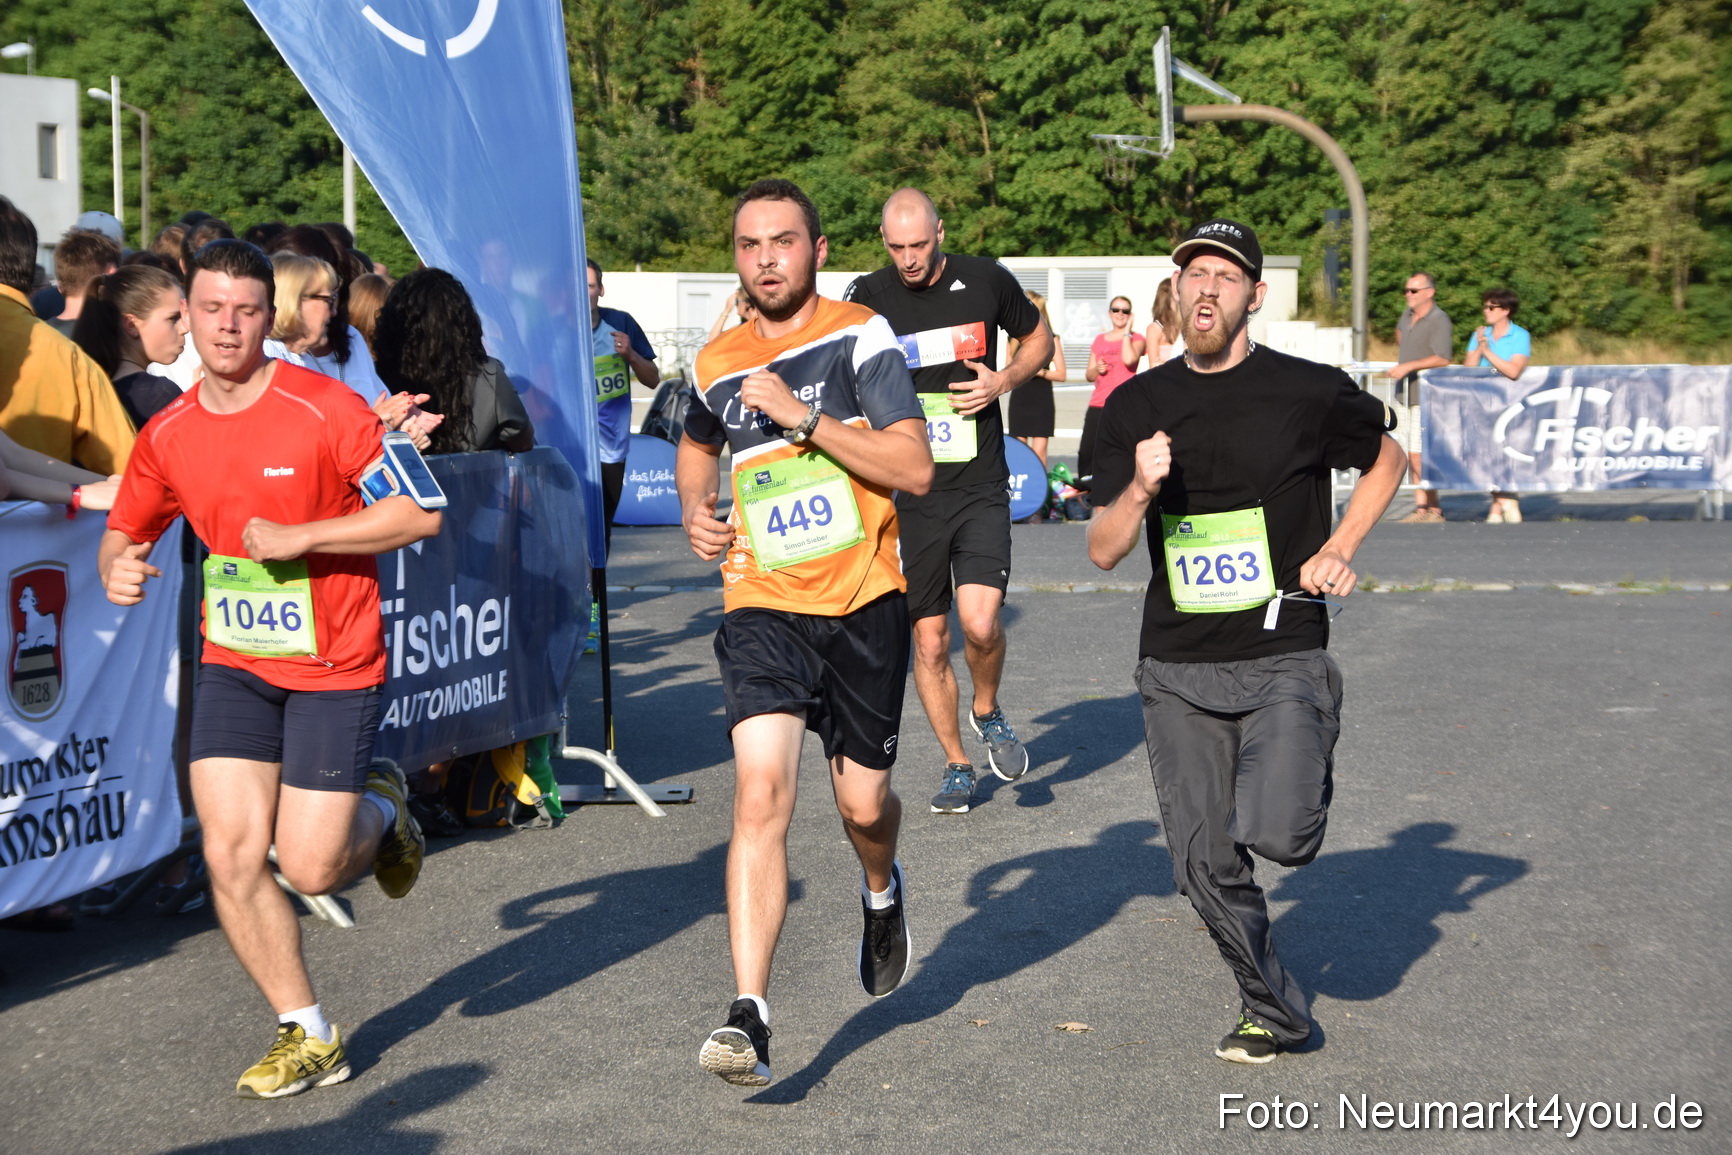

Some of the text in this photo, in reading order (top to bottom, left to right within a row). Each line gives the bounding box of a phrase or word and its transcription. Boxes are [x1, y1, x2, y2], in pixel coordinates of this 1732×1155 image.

[1533, 416, 1721, 454] Fischer
[263, 466, 295, 478] Florian
[1549, 455, 1705, 472] AUTOMOBILE
[629, 469, 649, 483] das
[766, 494, 833, 537] 449
[783, 538, 806, 551] Simon
[806, 533, 828, 546] Sieber
[1175, 551, 1260, 586] 1263
[1199, 591, 1220, 599] Daniel
[216, 596, 302, 632] 1046
[231, 635, 289, 646] Florian Maierhofer
[21, 681, 50, 706] 1628
[378, 669, 507, 731] AUTOMOBILE
